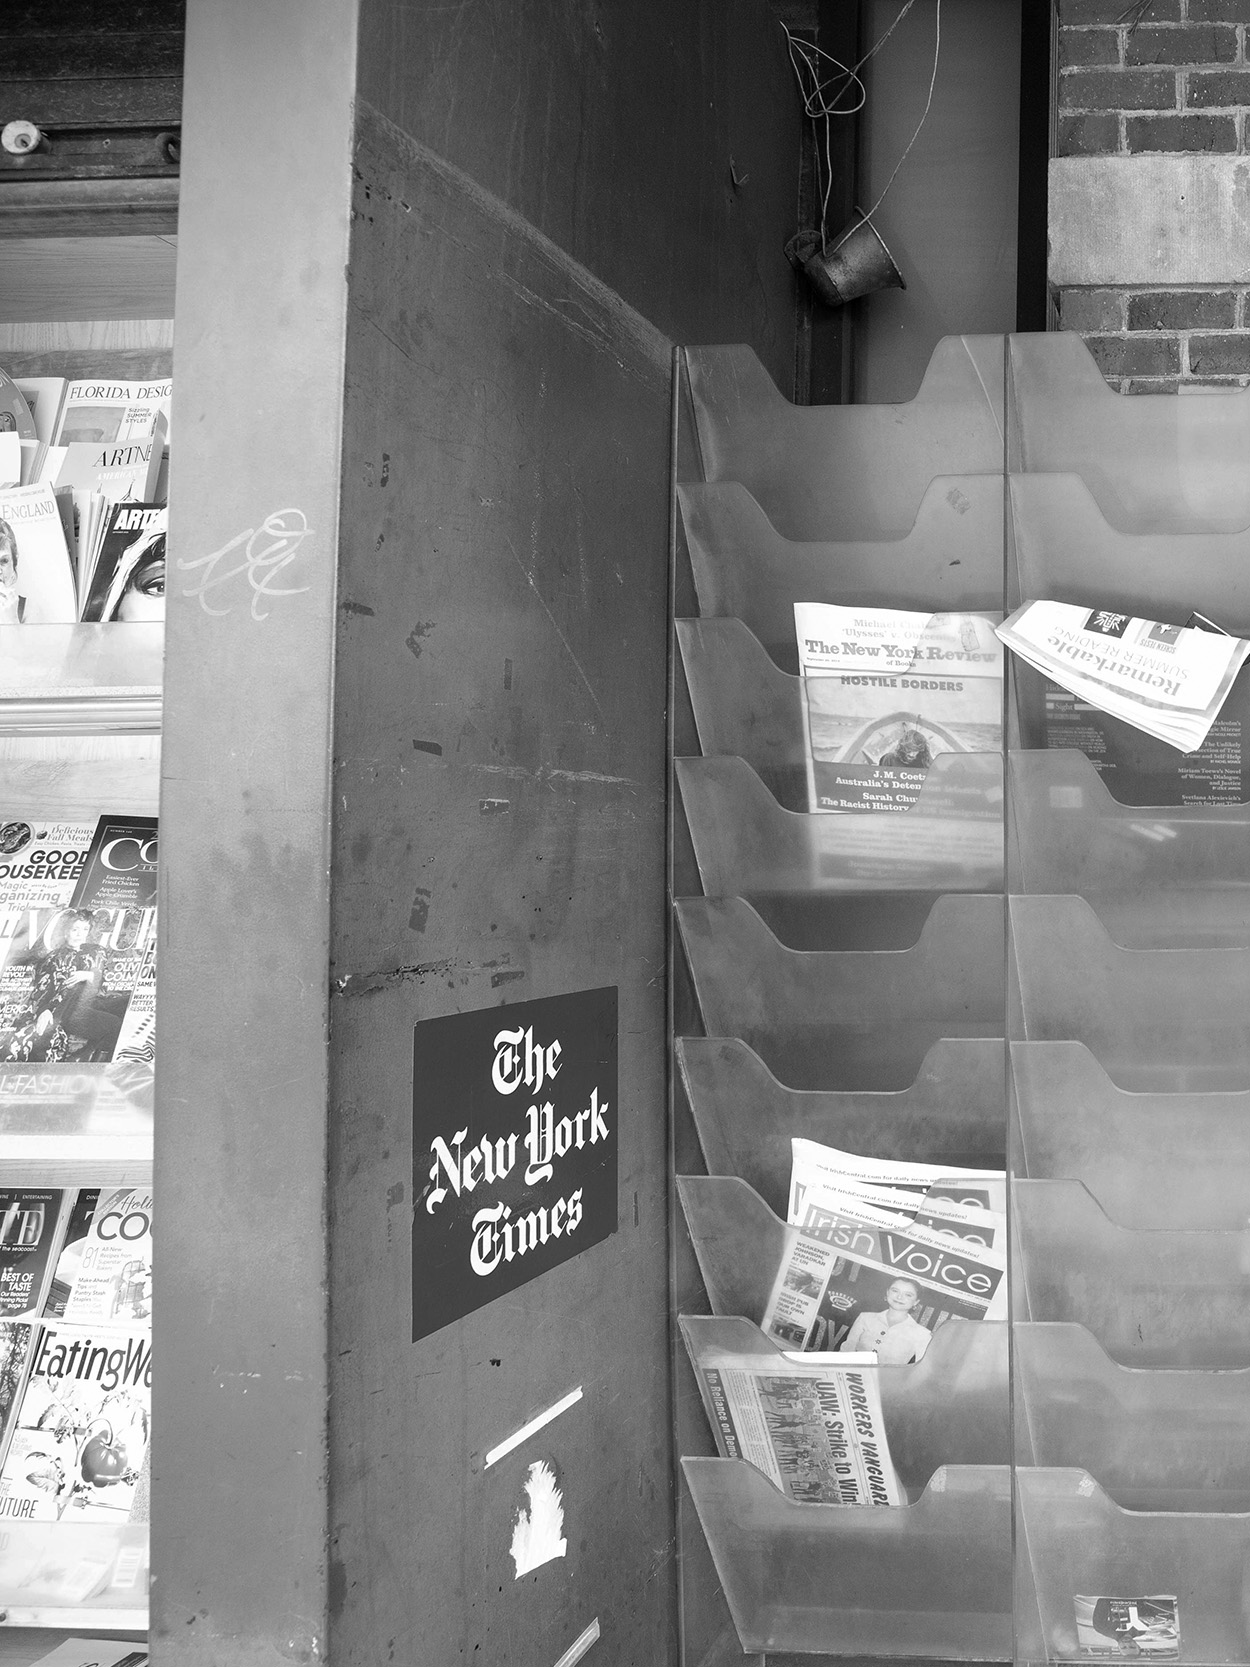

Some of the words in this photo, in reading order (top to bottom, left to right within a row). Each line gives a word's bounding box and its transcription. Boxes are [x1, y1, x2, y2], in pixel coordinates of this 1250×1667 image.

[70, 386, 131, 399] FLORIDA
[2, 501, 55, 520] ENGLAND
[854, 619, 896, 629] Michael
[805, 640, 840, 655] The
[841, 642, 881, 657] New
[881, 644, 924, 660] York
[926, 646, 998, 663] Review
[1054, 626, 1119, 660] READING
[1155, 642, 1176, 654] SCREEN
[896, 660, 917, 668] Books
[1047, 636, 1181, 697] Remarkable
[1124, 651, 1190, 682] SUMMER
[841, 675, 898, 688] HOSTILE
[901, 678, 964, 691] BORDERS
[835, 777, 889, 788] Australia's
[820, 796, 839, 806] The
[840, 799, 871, 810] Racist
[872, 801, 910, 812] History
[862, 792, 893, 801] Sarah
[30, 850, 89, 865] GOOD
[492, 1025, 562, 1095] The
[426, 1126, 519, 1214] New
[524, 1087, 610, 1186] York
[838, 1188, 893, 1203] IrishCentral.com
[904, 1201, 920, 1210] daily
[921, 1206, 937, 1214] news
[938, 1209, 968, 1219] updates!
[97, 1212, 152, 1240] CO
[470, 1188, 584, 1277] Times
[839, 1207, 854, 1215] Visit
[908, 1229, 917, 1237] for
[917, 1232, 933, 1244] daily
[934, 1240, 951, 1249] news
[950, 1245, 980, 1259] updates!
[796, 1241, 830, 1257] WEAKENED
[806, 1208, 875, 1255] Irish
[887, 1235, 992, 1294] Voice
[793, 1252, 826, 1267] VARADKAR
[1, 1273, 20, 1281] BEST
[22, 1273, 34, 1281] OF
[9, 1283, 32, 1291] TASTE
[706, 1372, 720, 1384] No
[711, 1386, 727, 1422] Reliance
[816, 1381, 841, 1416] UAW:
[721, 1423, 732, 1434] on
[724, 1435, 738, 1458] Demo
[824, 1420, 849, 1459] Strike
[846, 1372, 875, 1439] WORKERS
[861, 1441, 890, 1506] VANGUARD
[835, 1462, 853, 1475] to
